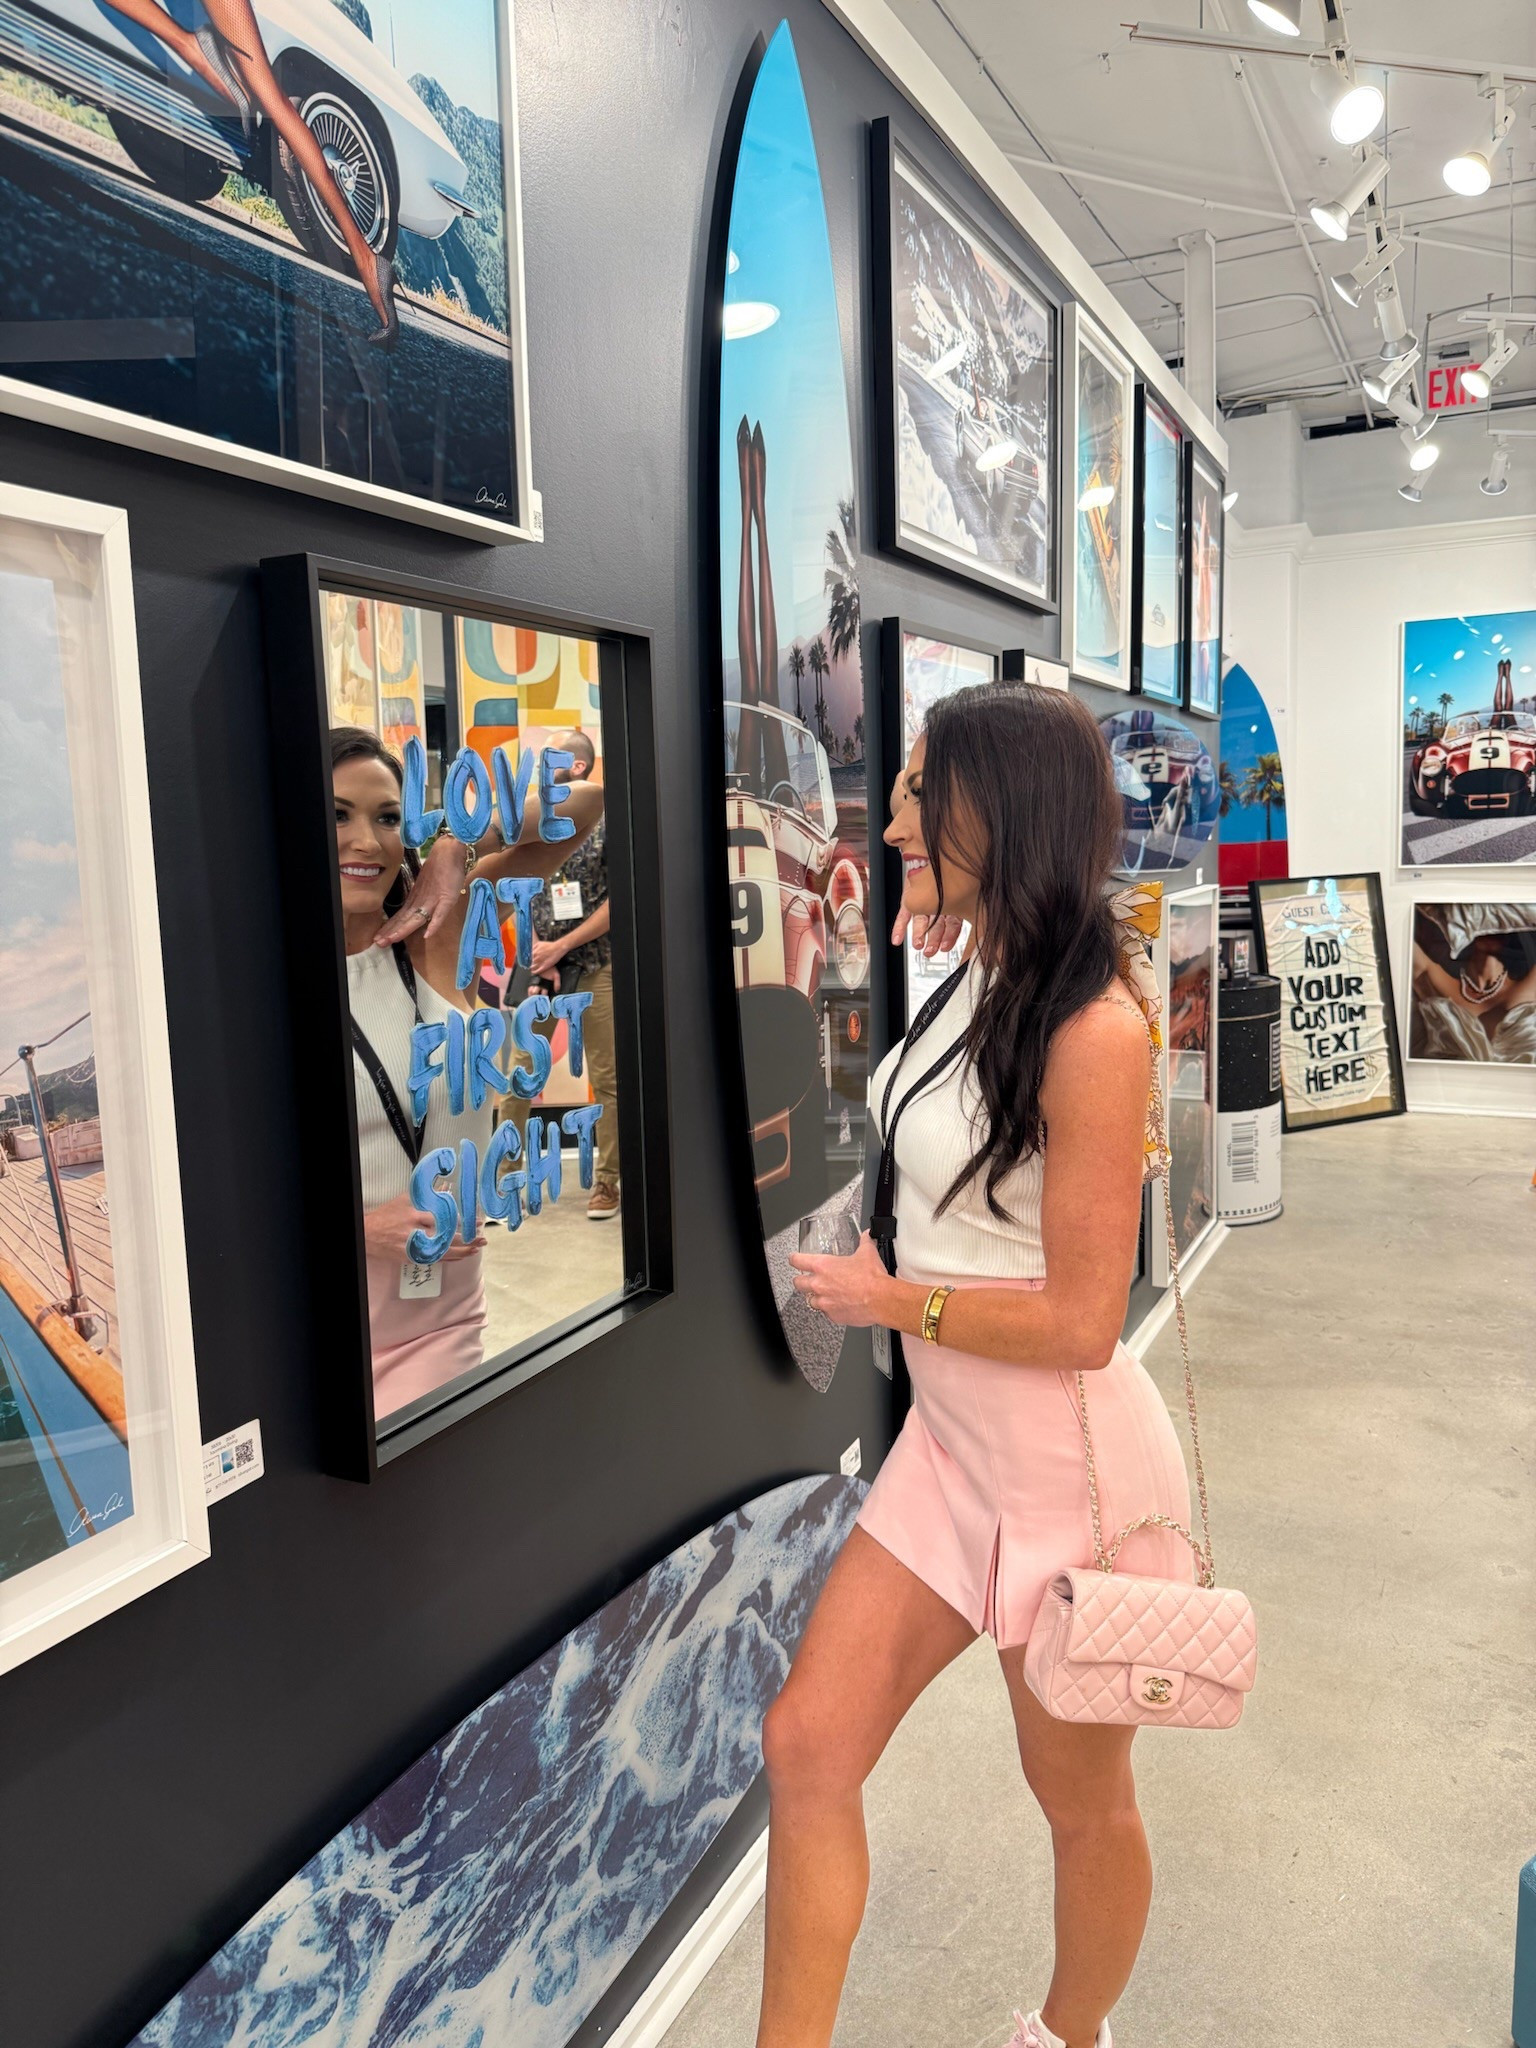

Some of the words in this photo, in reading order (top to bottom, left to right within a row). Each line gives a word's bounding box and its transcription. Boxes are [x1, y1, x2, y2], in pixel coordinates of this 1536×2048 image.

[401, 734, 576, 849] LOVE
[456, 877, 544, 990] AT
[729, 881, 764, 947] 9
[1304, 935, 1341, 969] ADD
[1288, 973, 1364, 1004] YOUR
[1290, 1001, 1367, 1032] CUSTOM
[409, 993, 594, 1128] FIRST
[1304, 1026, 1360, 1060] TEXT
[1305, 1057, 1366, 1094] HERE
[406, 1104, 603, 1264] SIGHT
